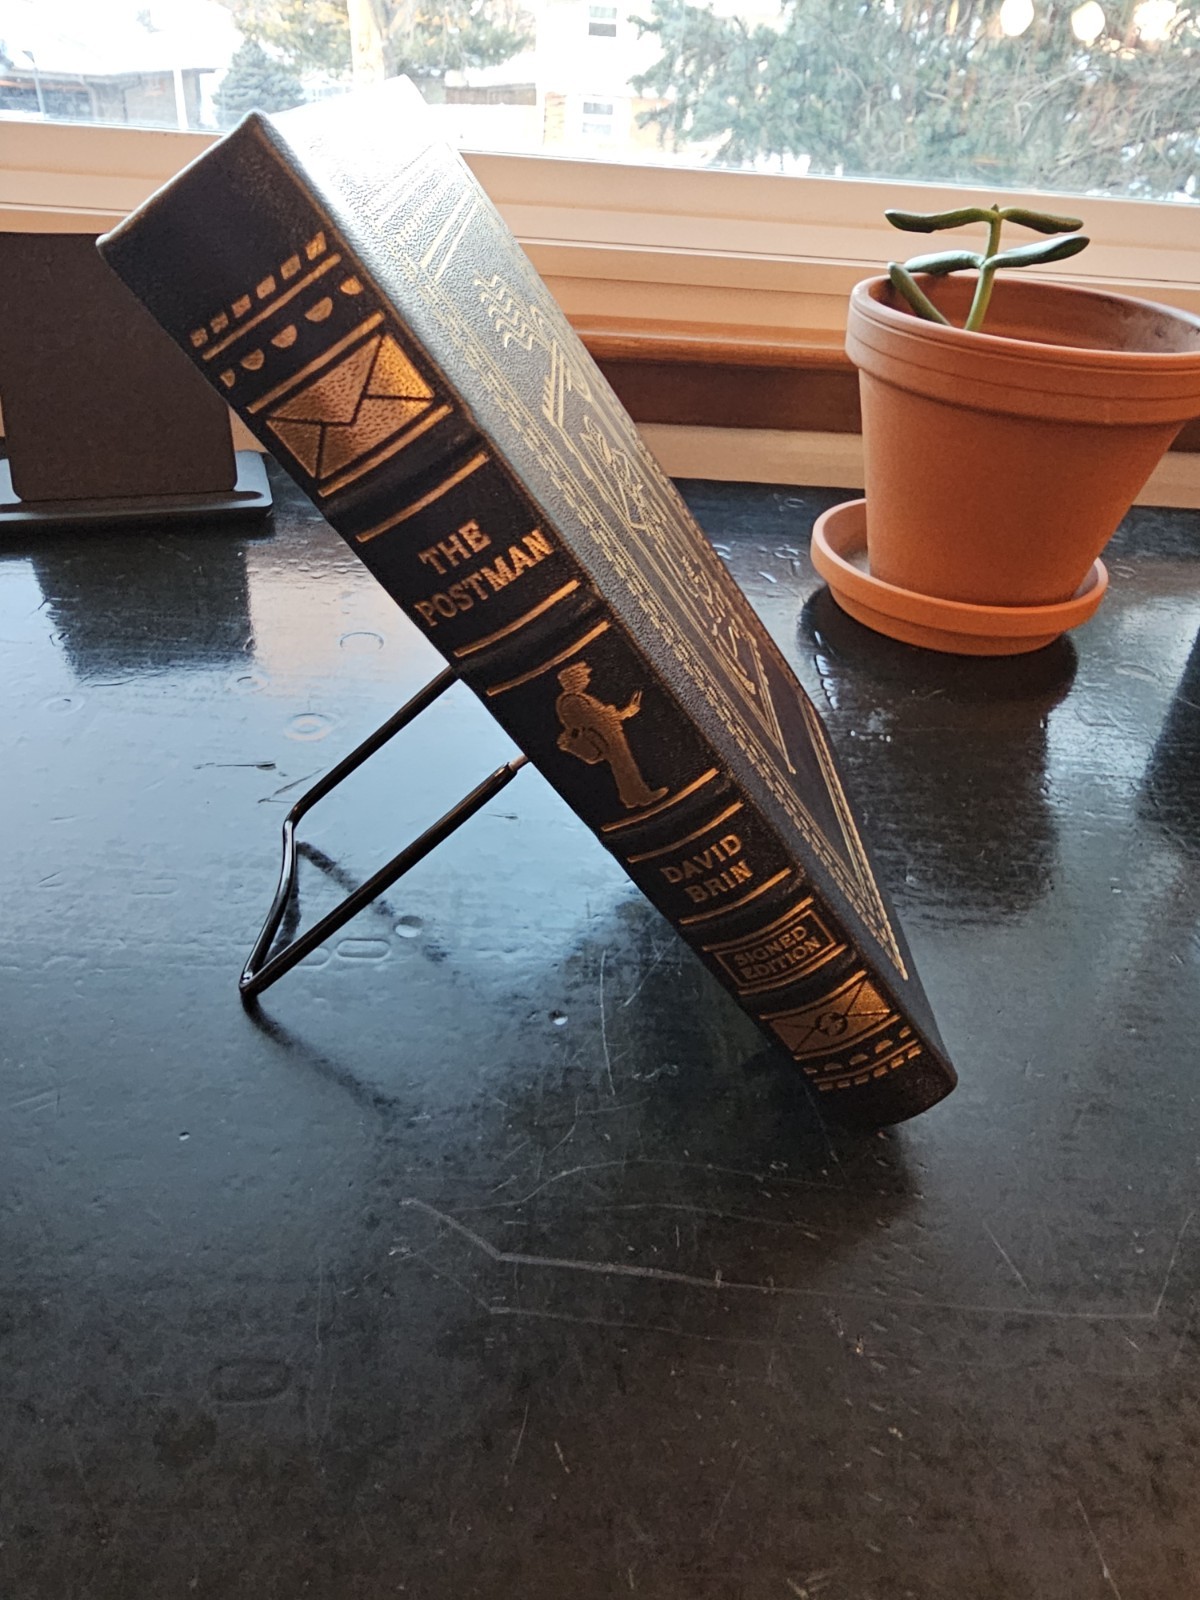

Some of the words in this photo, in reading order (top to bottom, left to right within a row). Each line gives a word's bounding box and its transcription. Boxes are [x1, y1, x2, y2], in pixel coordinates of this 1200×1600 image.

[418, 519, 492, 575] THE
[414, 530, 555, 627] POSTMAN
[661, 834, 742, 883] DAVID
[686, 860, 753, 903] BRIN
[734, 927, 807, 965] SIGNED
[742, 936, 821, 979] EDITION
